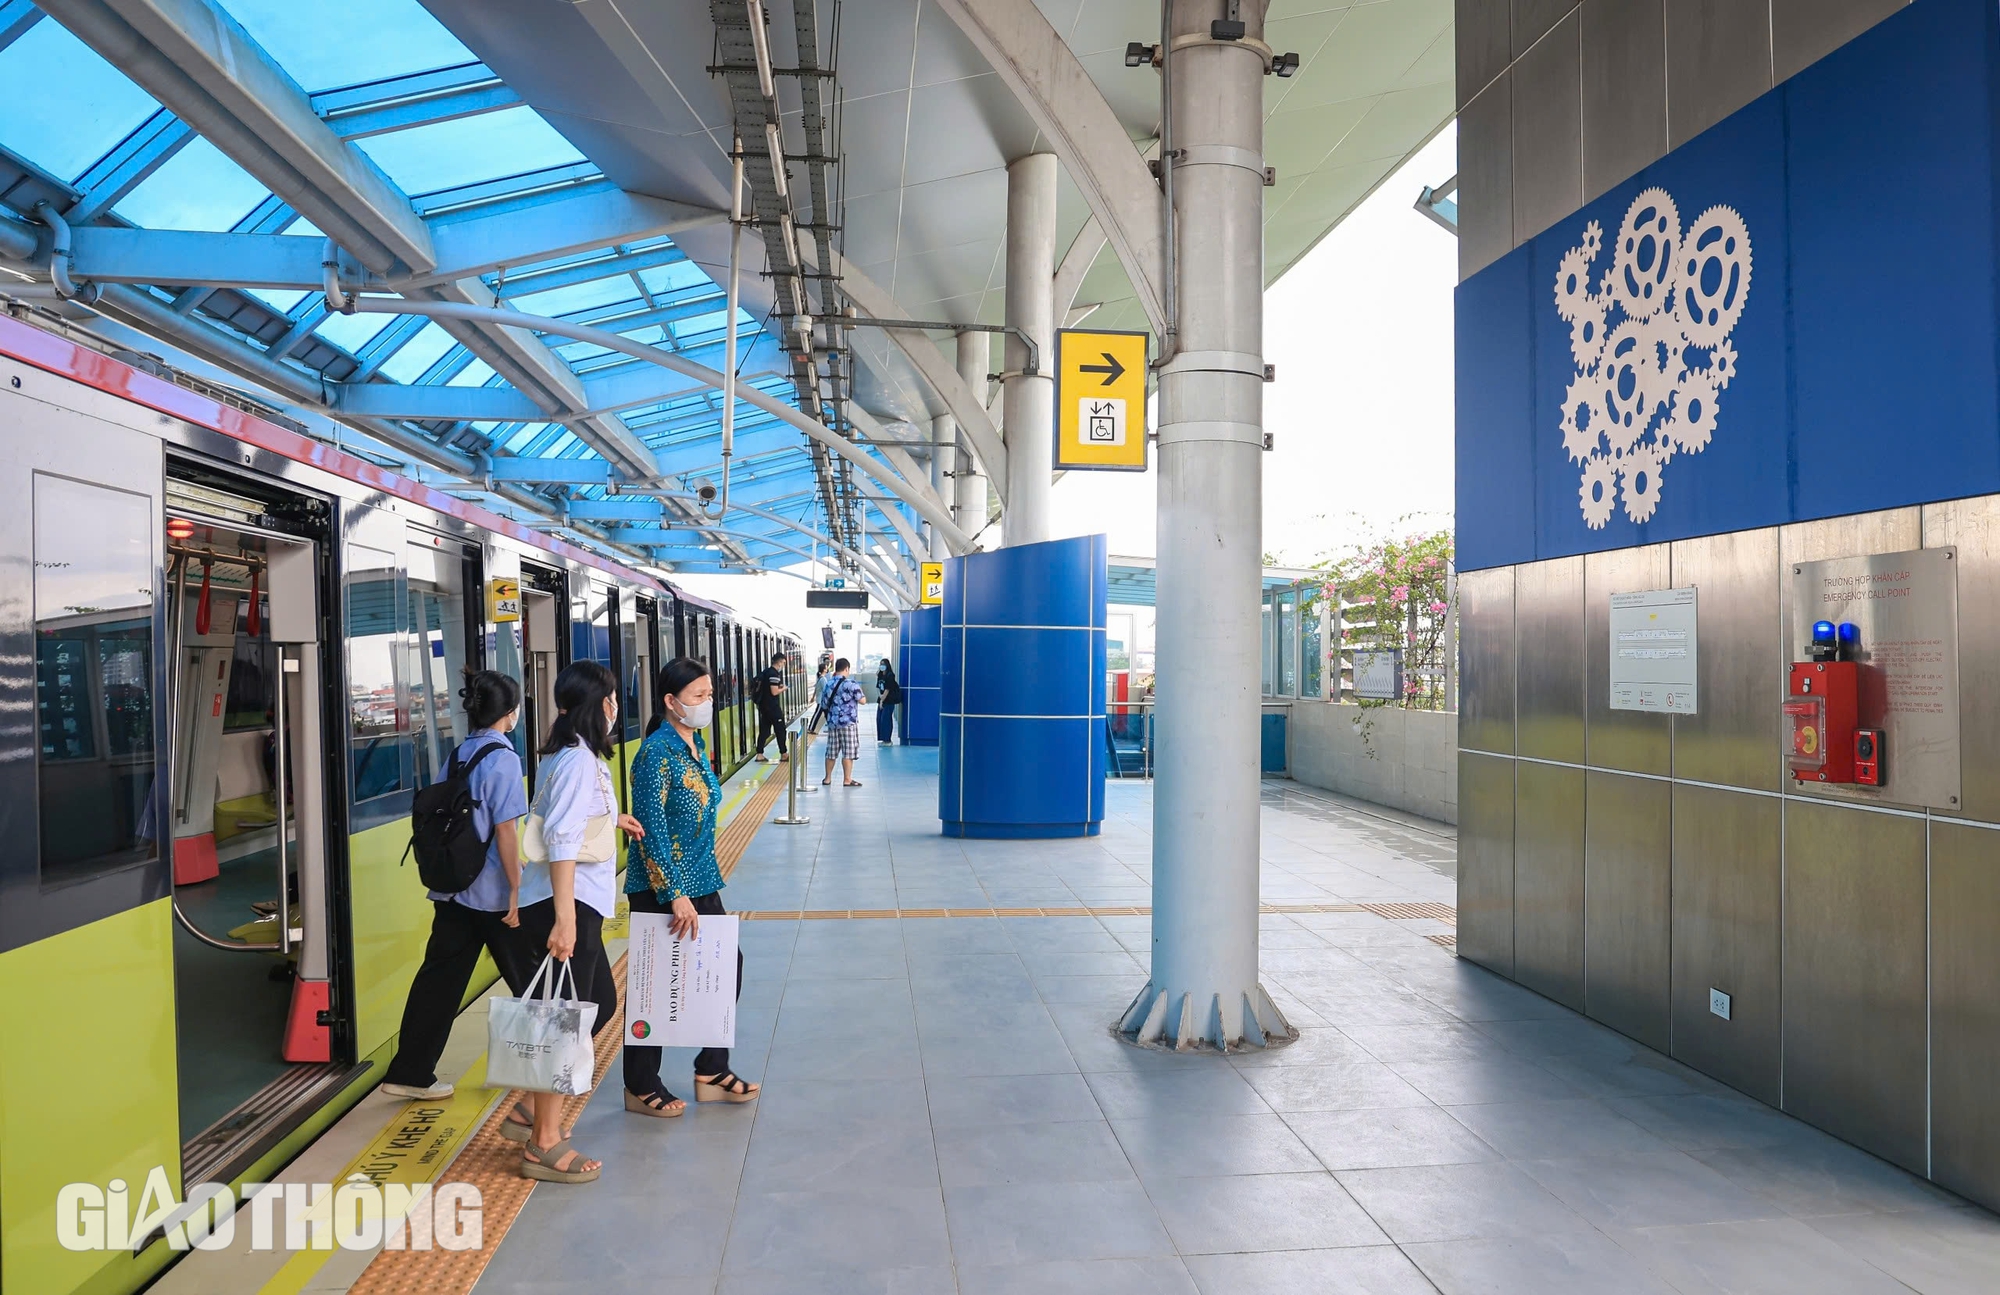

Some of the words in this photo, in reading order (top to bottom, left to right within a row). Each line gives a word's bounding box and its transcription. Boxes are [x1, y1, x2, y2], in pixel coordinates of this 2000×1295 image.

[1823, 591, 1867, 603] EMERGENCY
[1868, 590, 1886, 600] CALL
[1887, 587, 1911, 598] POINT
[671, 941, 680, 967] PHIM
[669, 969, 680, 999] DỰNG
[669, 1001, 678, 1022] BAO
[386, 1126, 432, 1149] KHE
[371, 1151, 407, 1160] Ý
[416, 1149, 440, 1165] MIND
[429, 1138, 449, 1149] THE
